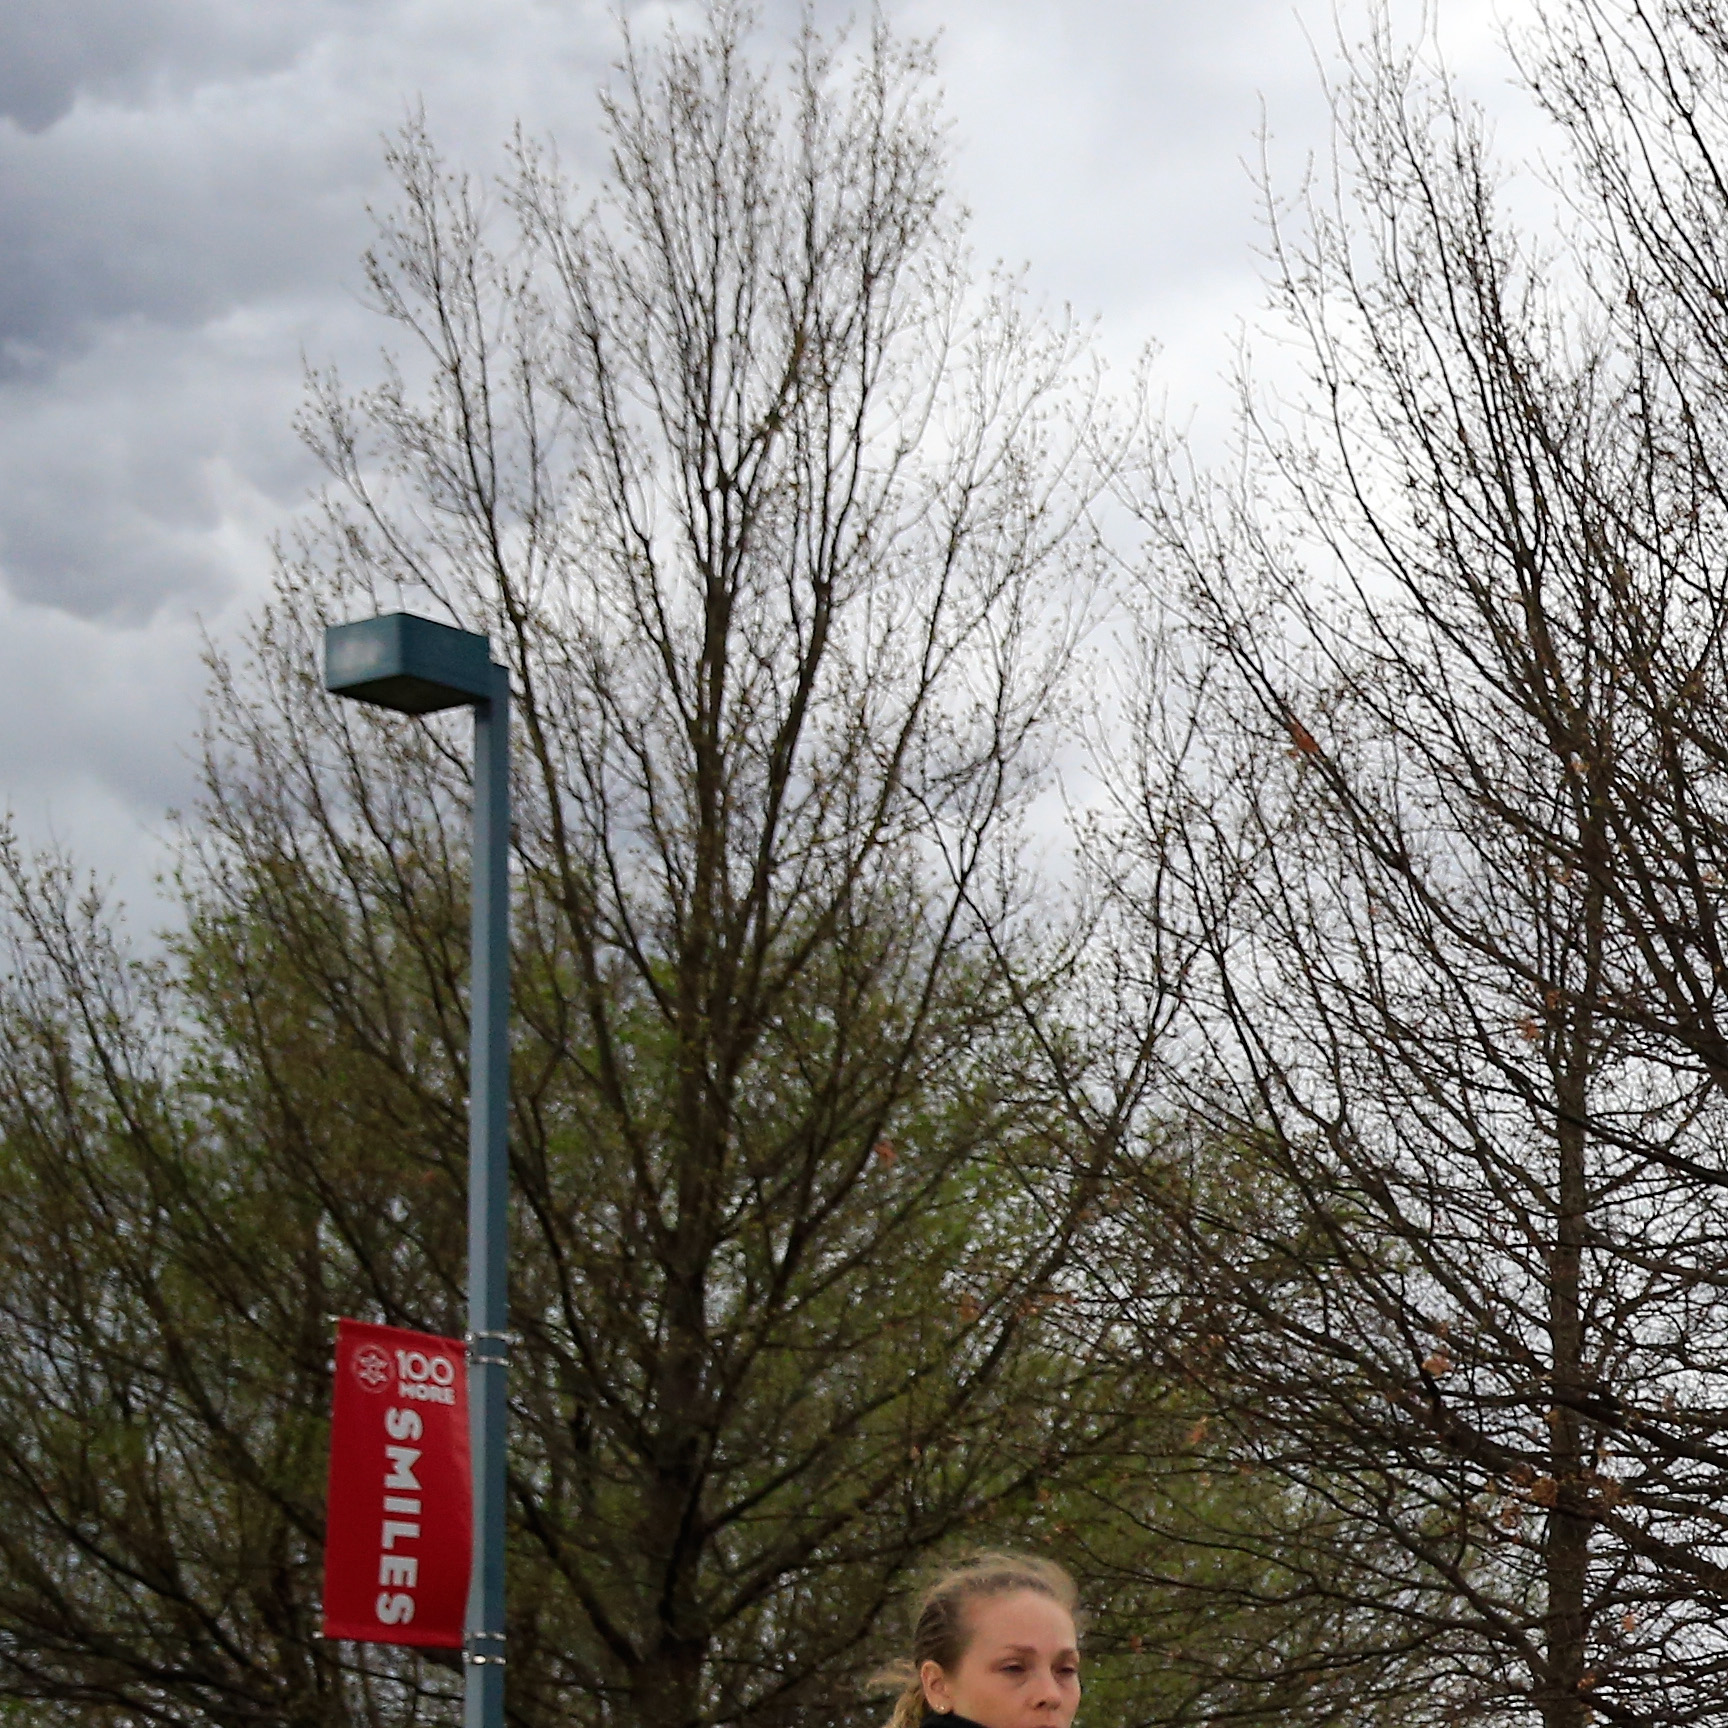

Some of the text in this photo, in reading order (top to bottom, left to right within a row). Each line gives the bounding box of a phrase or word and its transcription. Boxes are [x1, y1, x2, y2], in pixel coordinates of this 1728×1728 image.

[394, 1349, 455, 1386] 100
[398, 1380, 456, 1406] MORE
[376, 1406, 425, 1625] SMILES
